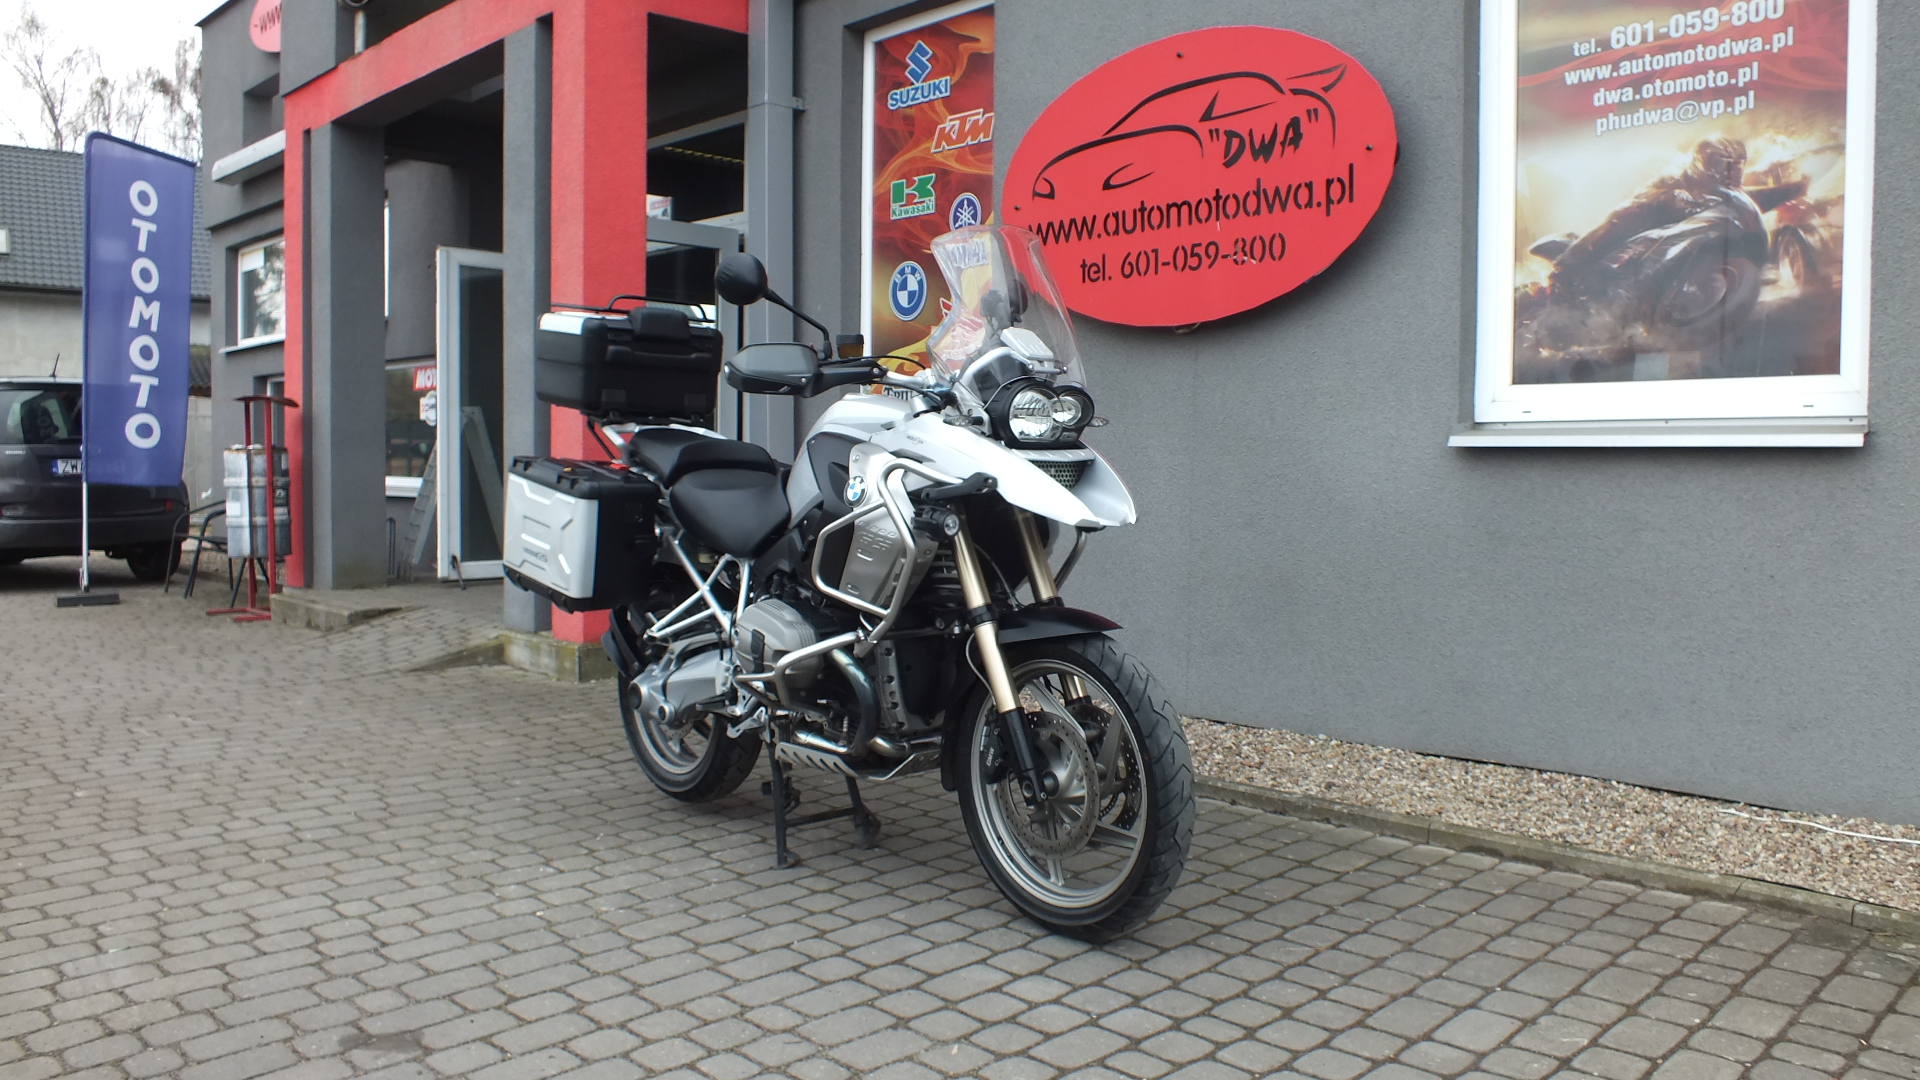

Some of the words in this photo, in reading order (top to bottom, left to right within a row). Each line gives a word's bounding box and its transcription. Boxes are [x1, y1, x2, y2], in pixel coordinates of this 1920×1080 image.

[1572, 38, 1602, 57] tel.
[1609, 0, 1786, 50] 601-059-800
[1564, 26, 1795, 86] www.automotodwa.pl
[888, 77, 951, 110] SUZUKI
[1592, 61, 1759, 108] dwa.otomoto.pl
[931, 109, 994, 153] KTM
[1595, 90, 1756, 136] phudwa@vp.pl
[890, 201, 936, 219] Kawasaki
[1028, 163, 1355, 247] www.automotodwa.pl
[1079, 252, 1113, 284] tel.
[1120, 231, 1288, 280] 601-059-800
[124, 179, 162, 449] OTOMOTO
